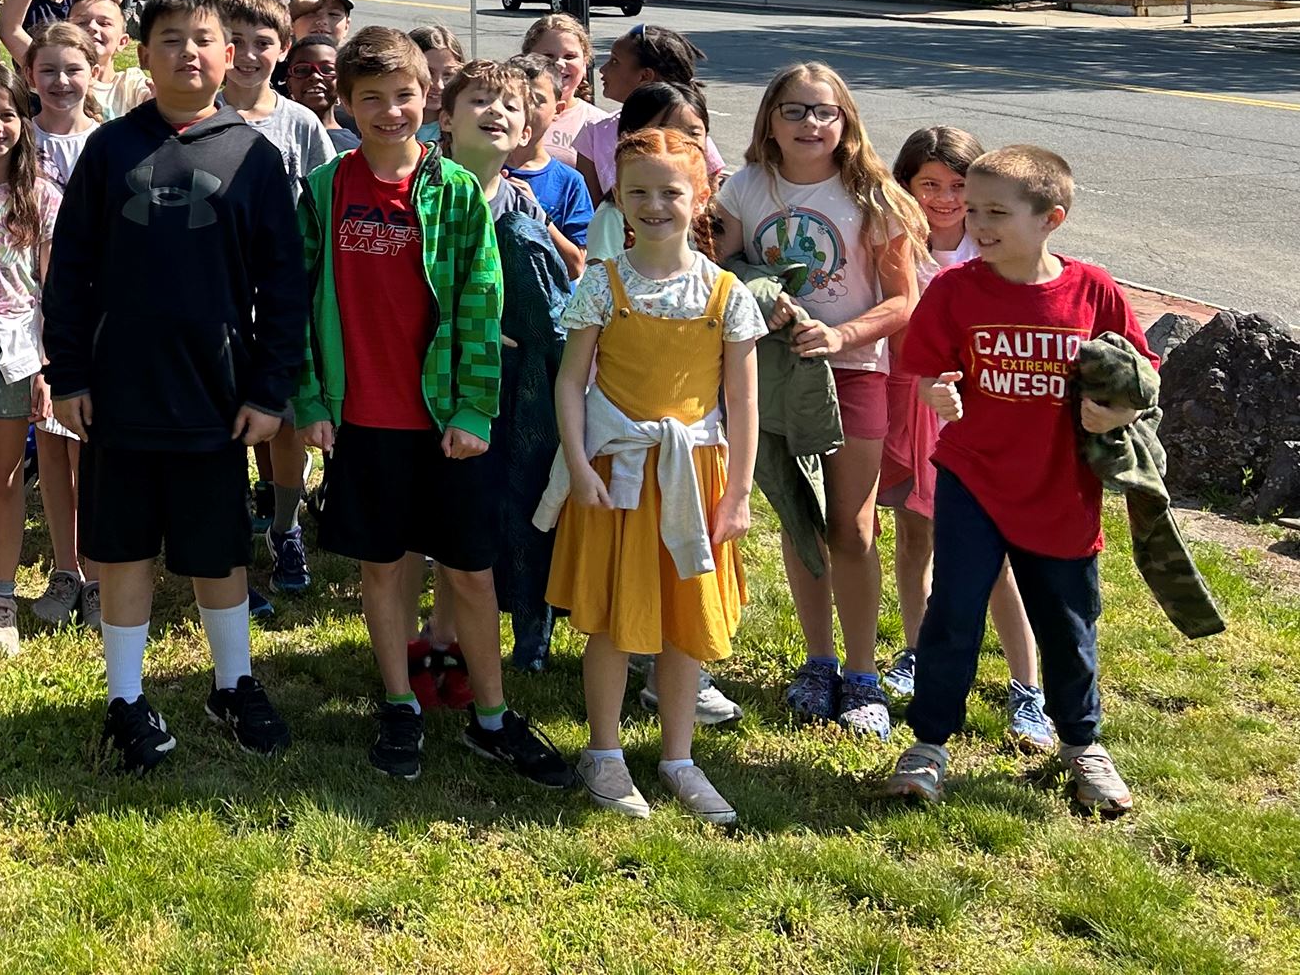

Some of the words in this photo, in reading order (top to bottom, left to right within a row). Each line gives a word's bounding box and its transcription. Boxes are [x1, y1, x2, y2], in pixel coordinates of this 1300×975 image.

[342, 203, 413, 225] FAS
[339, 219, 421, 243] NEVER
[339, 235, 406, 256] LAST
[975, 331, 1080, 361] CAUTIO
[1001, 359, 1068, 374] EXTREMEL
[980, 368, 1065, 399] AWESO
